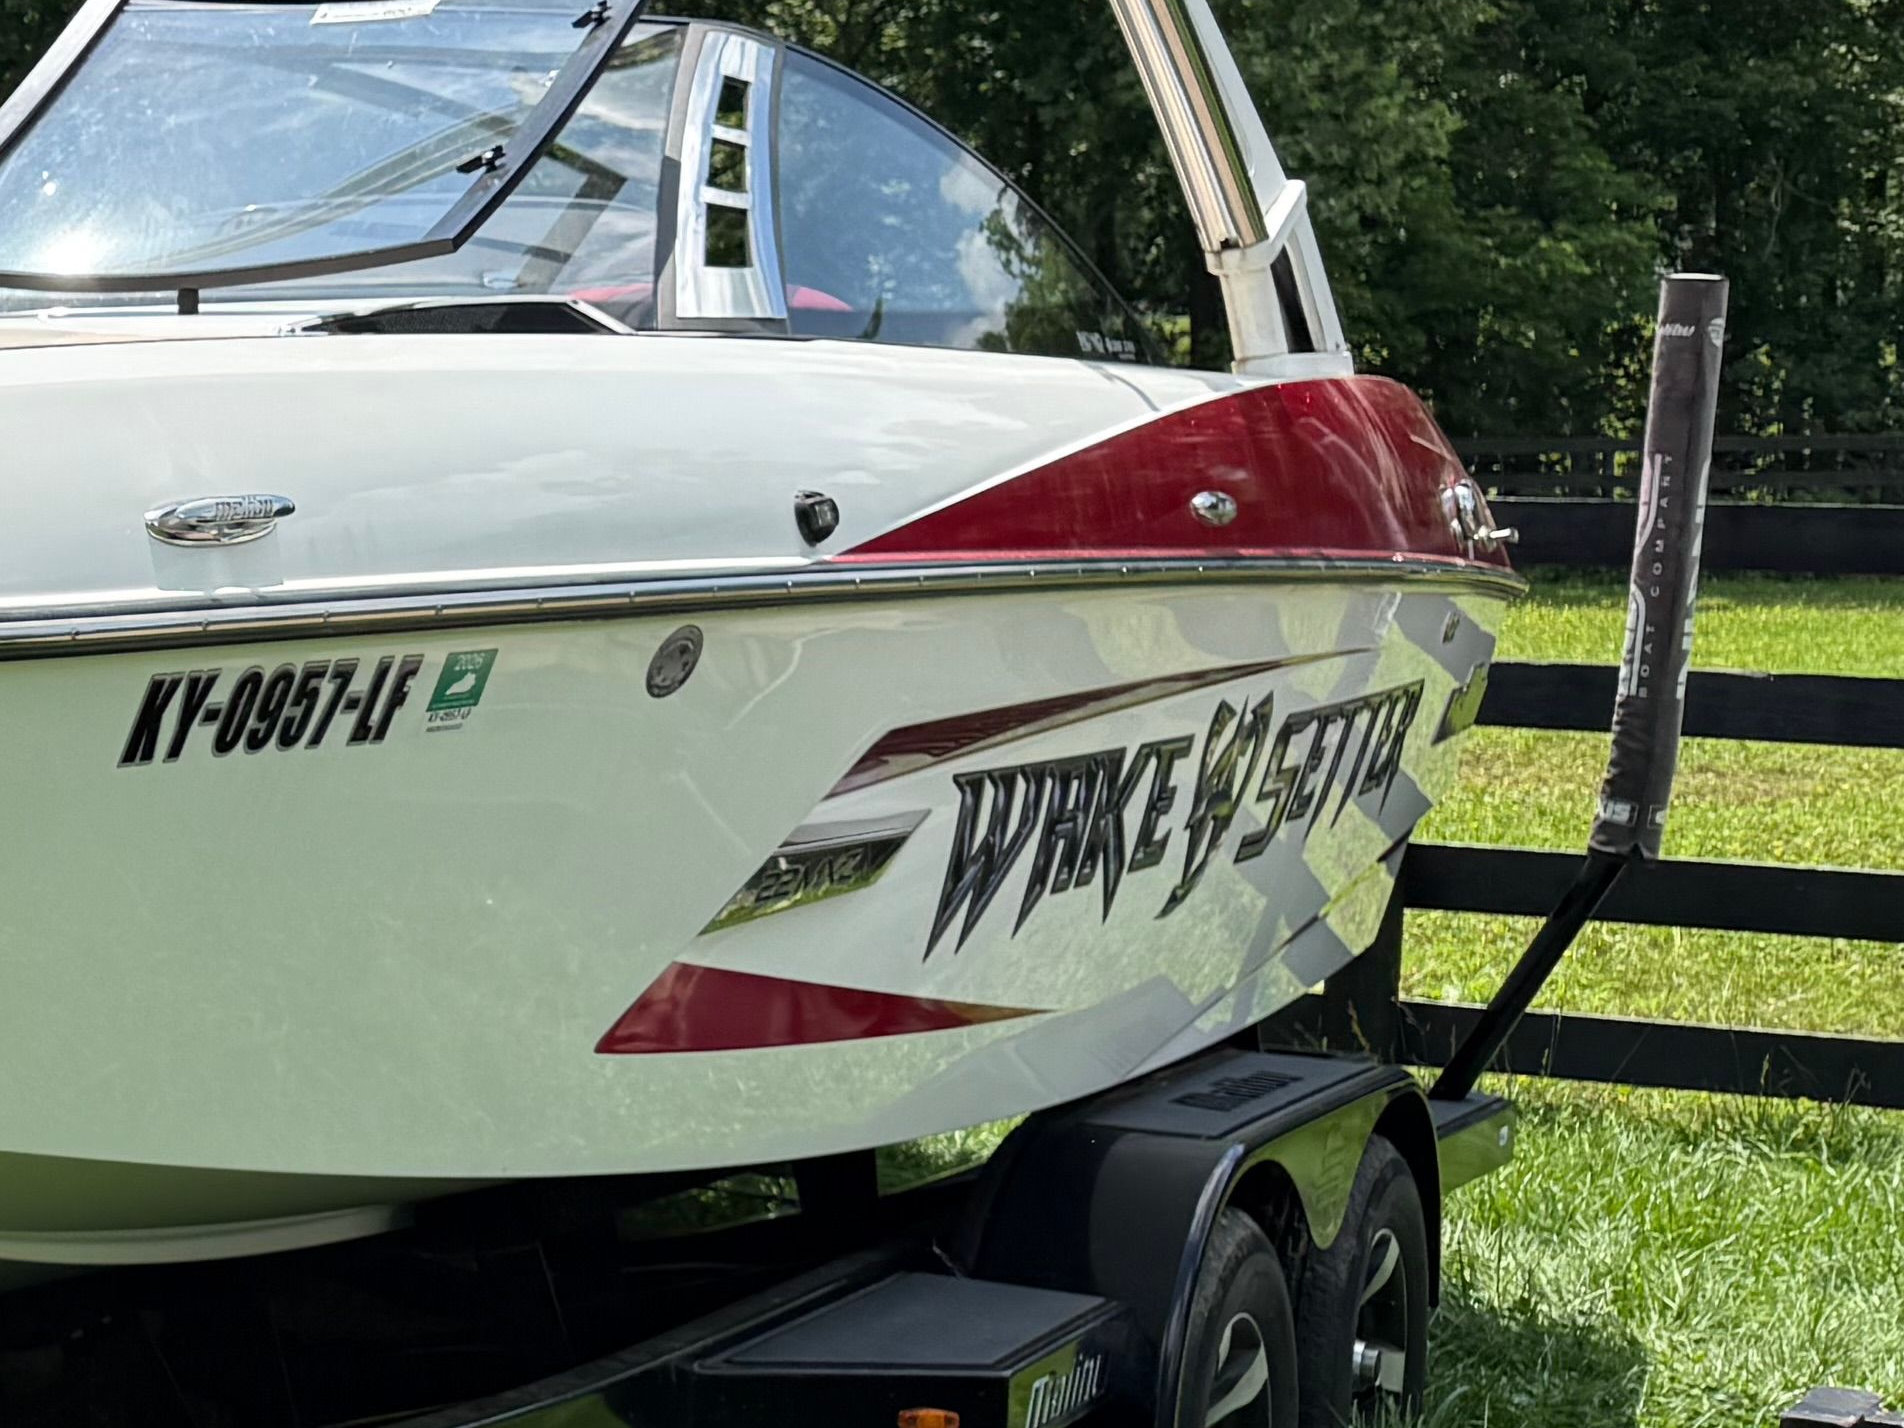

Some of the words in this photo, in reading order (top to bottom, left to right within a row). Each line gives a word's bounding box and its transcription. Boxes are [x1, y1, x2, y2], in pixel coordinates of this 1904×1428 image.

[1637, 624, 1656, 698] BOAT
[1649, 453, 1674, 598] COMPANY
[116, 653, 425, 769] KY-0957-LF
